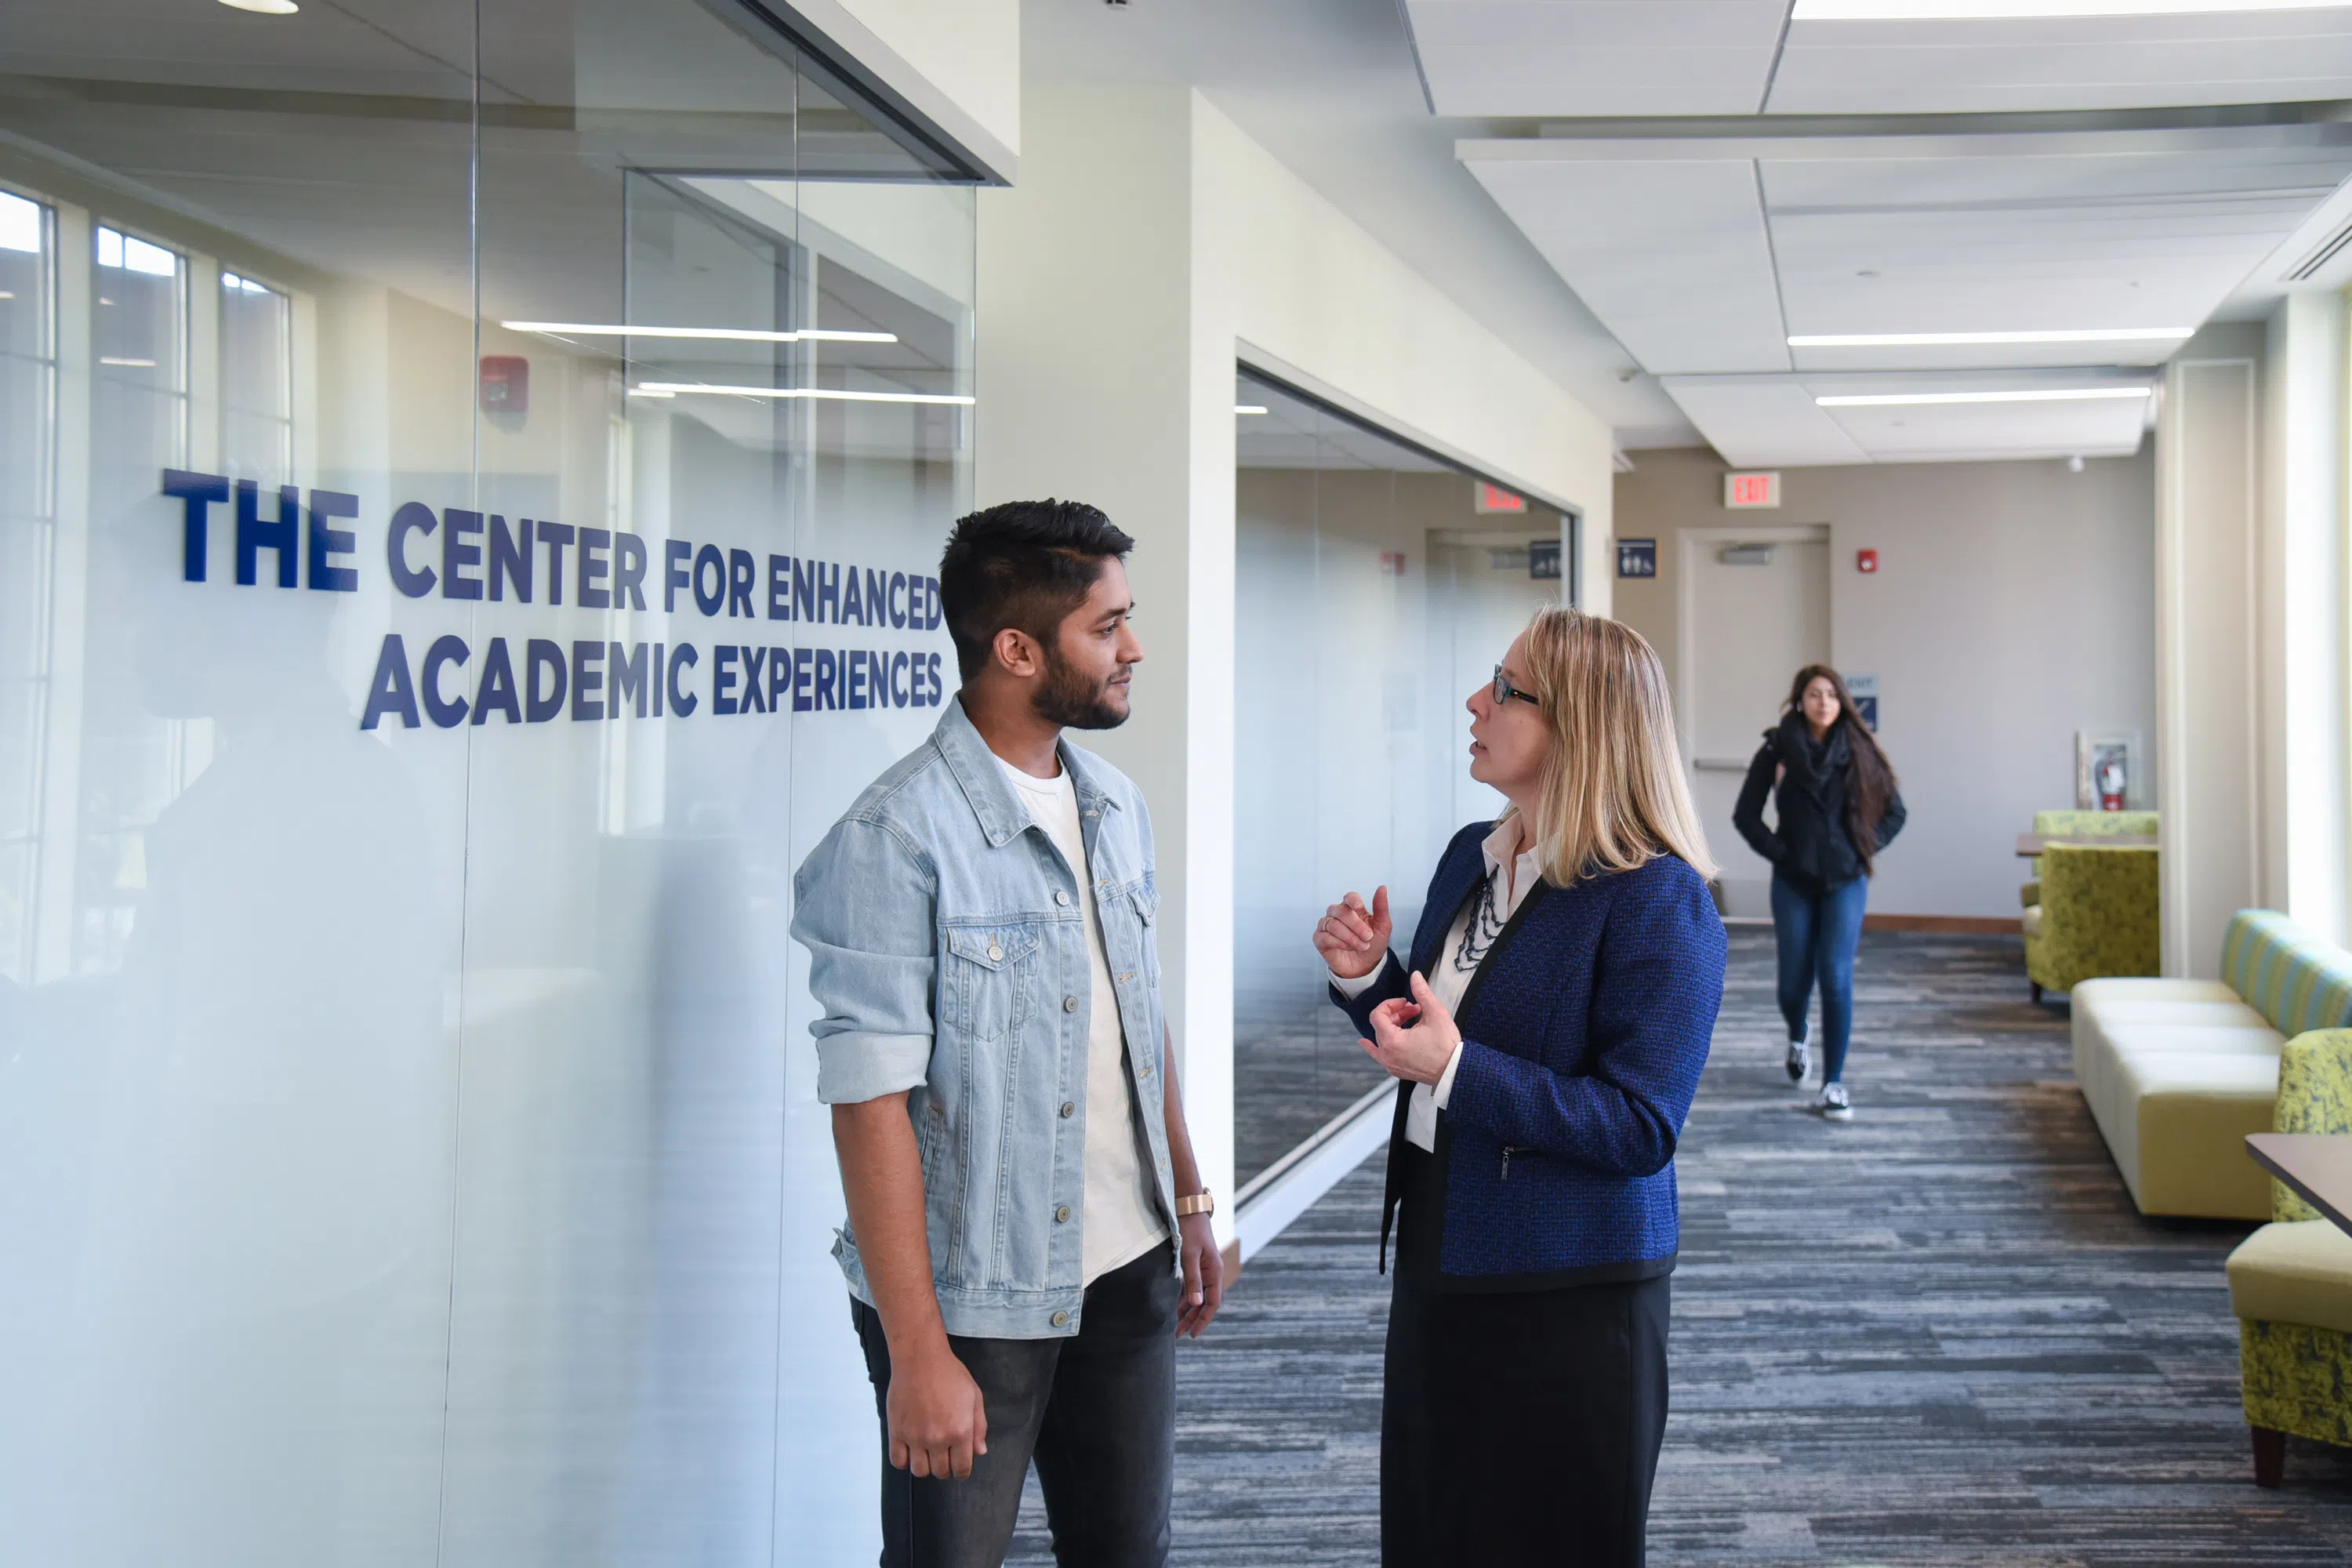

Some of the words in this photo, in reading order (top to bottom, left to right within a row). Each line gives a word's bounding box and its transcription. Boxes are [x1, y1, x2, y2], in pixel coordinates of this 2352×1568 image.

[1734, 476, 1769, 504] EXIT
[163, 468, 359, 592] THE
[388, 502, 648, 612] CENTER
[664, 539, 755, 618] FOR
[768, 554, 941, 630] ENHANCED
[361, 633, 699, 730] ACADEMIC
[713, 644, 942, 715] EXPERIENCES
